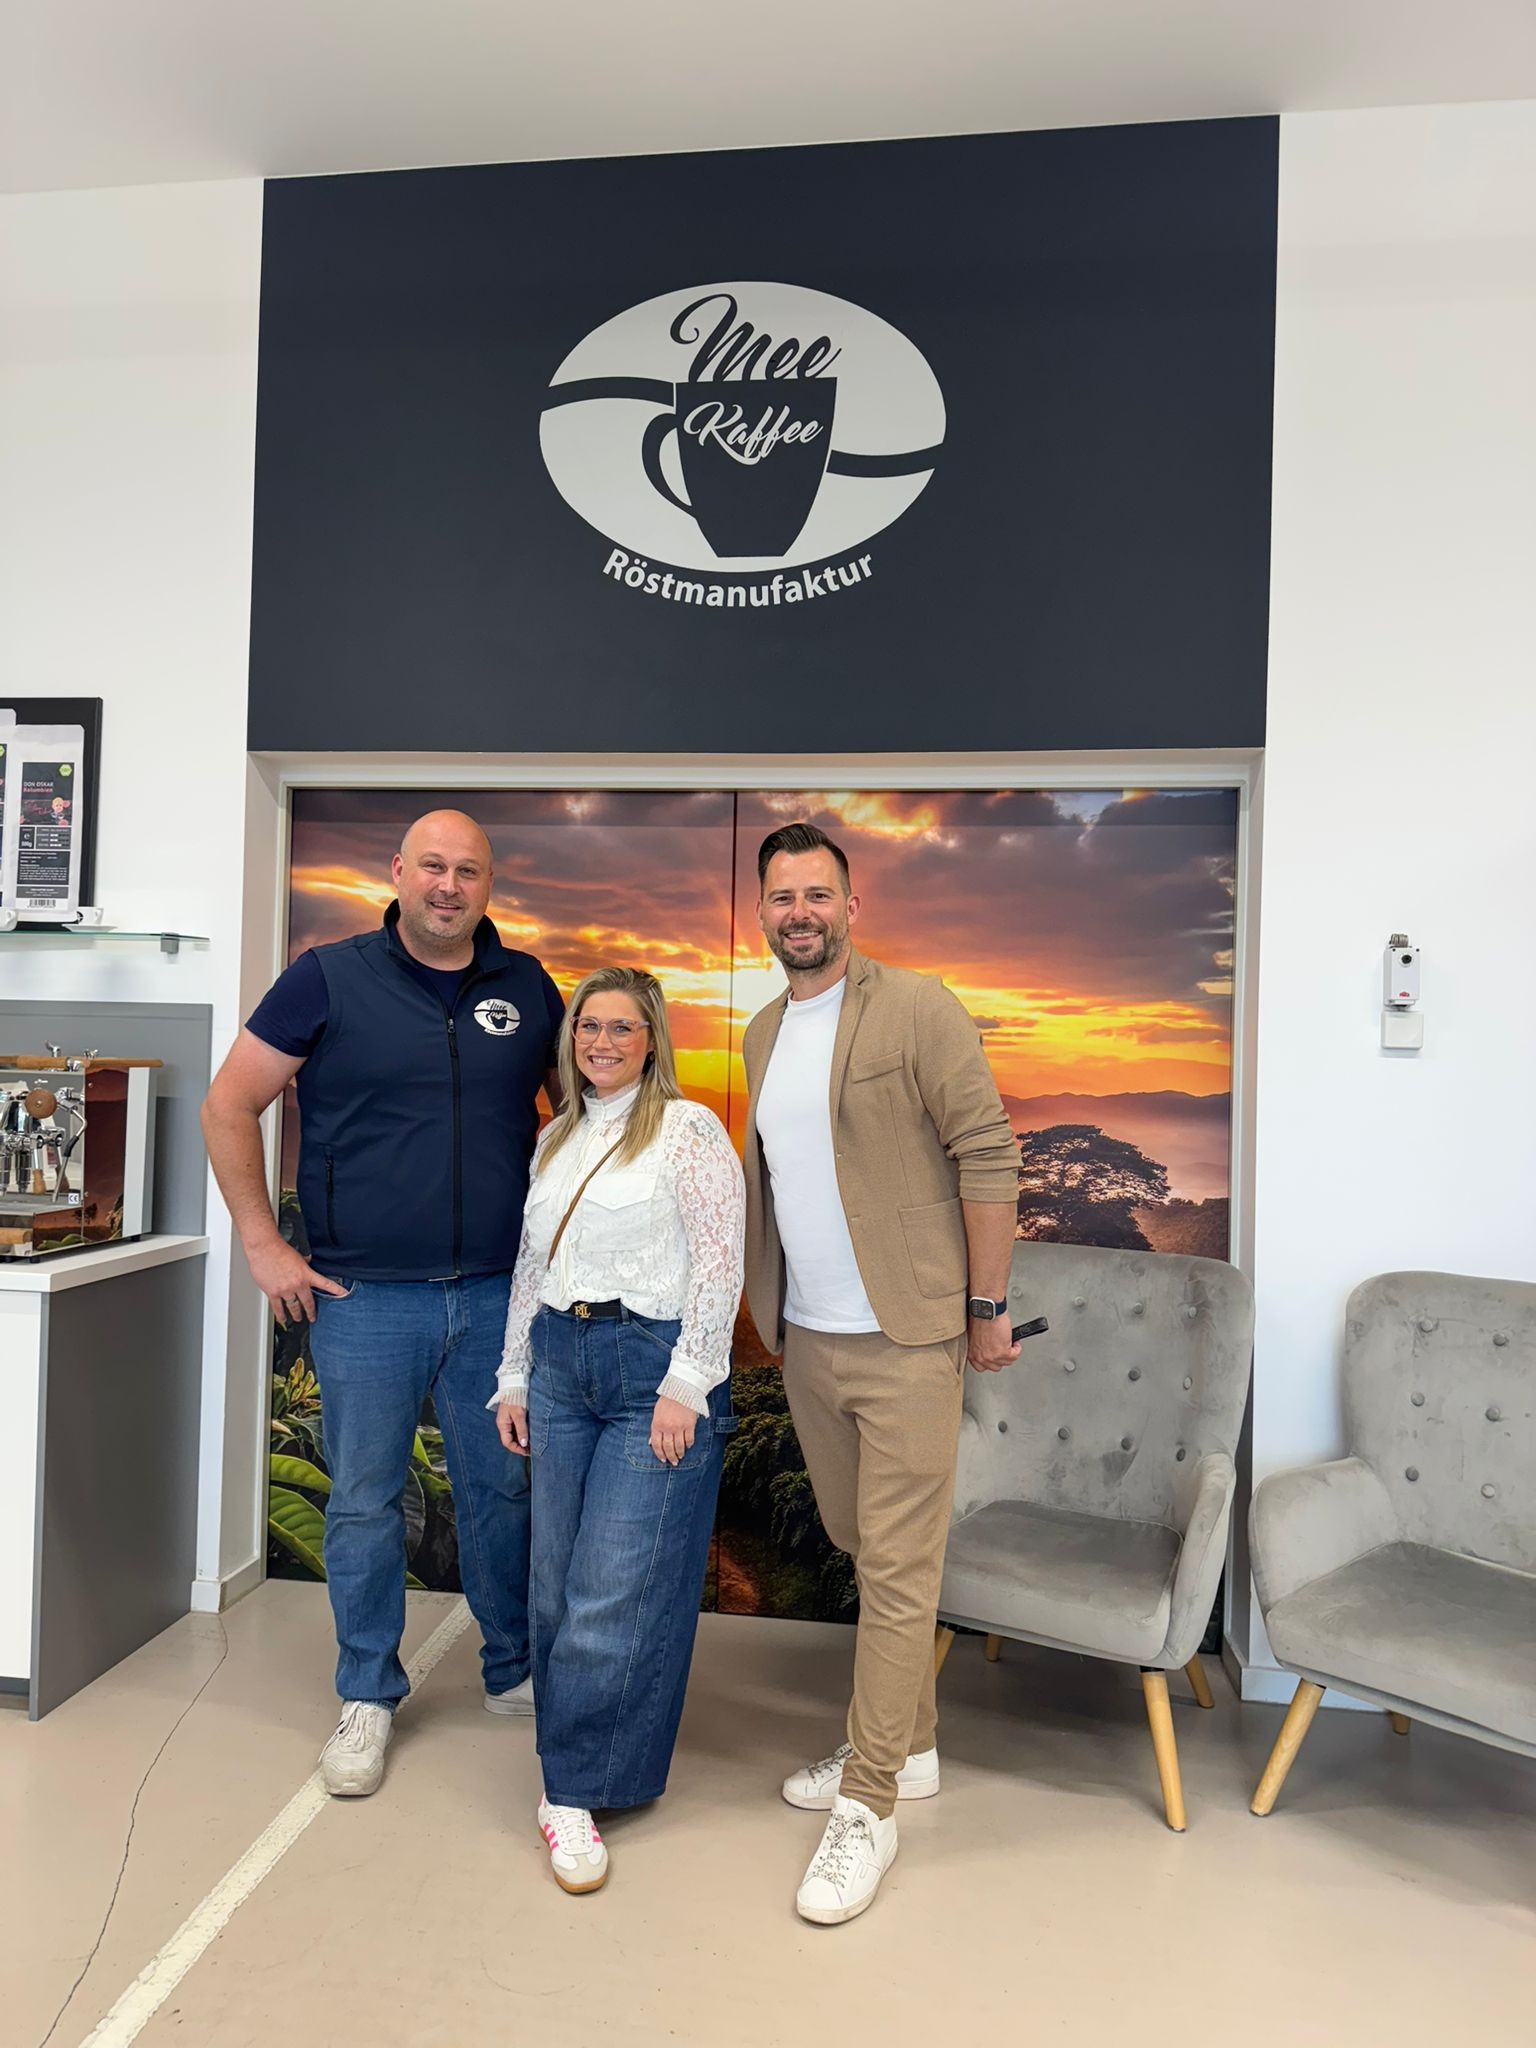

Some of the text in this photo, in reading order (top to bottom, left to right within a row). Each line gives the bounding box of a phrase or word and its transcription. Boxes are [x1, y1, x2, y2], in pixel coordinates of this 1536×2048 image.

[670, 293, 842, 383] Mee
[683, 401, 824, 465] Kaffee
[602, 547, 874, 608] Röstmanufaktur
